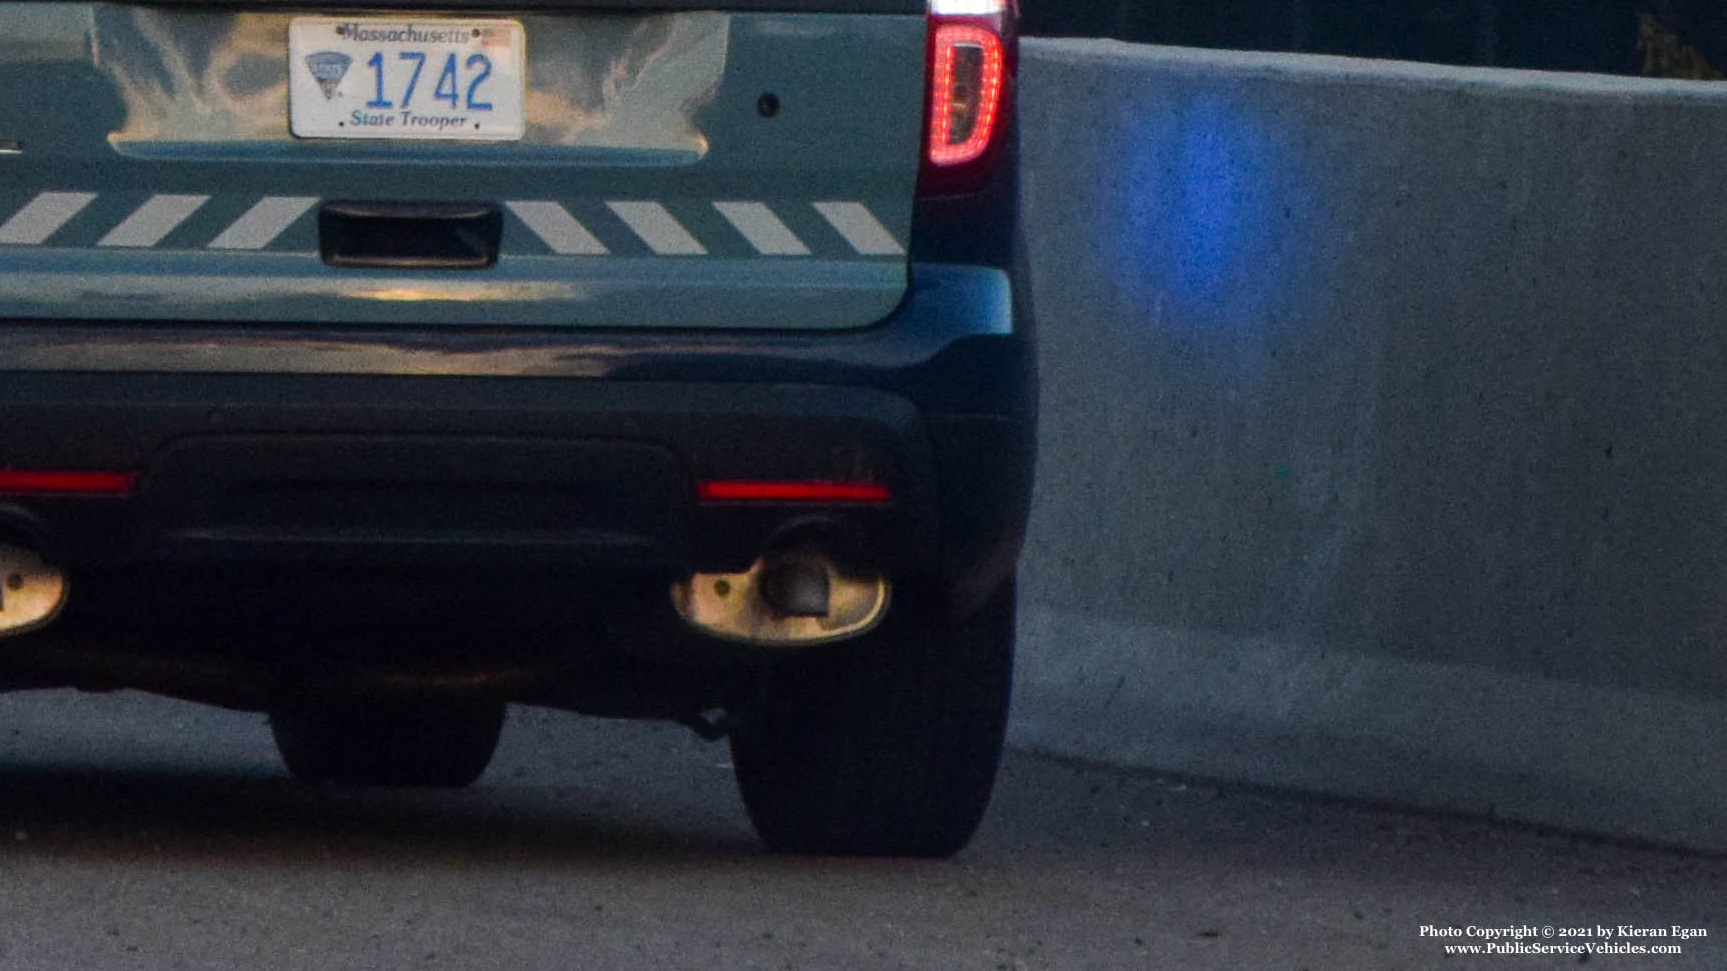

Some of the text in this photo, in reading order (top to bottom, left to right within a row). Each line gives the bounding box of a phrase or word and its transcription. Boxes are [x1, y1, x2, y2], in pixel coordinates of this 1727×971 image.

[343, 23, 471, 45] Massachusetts
[365, 51, 494, 111] 1742
[350, 109, 468, 131] State Trooper
